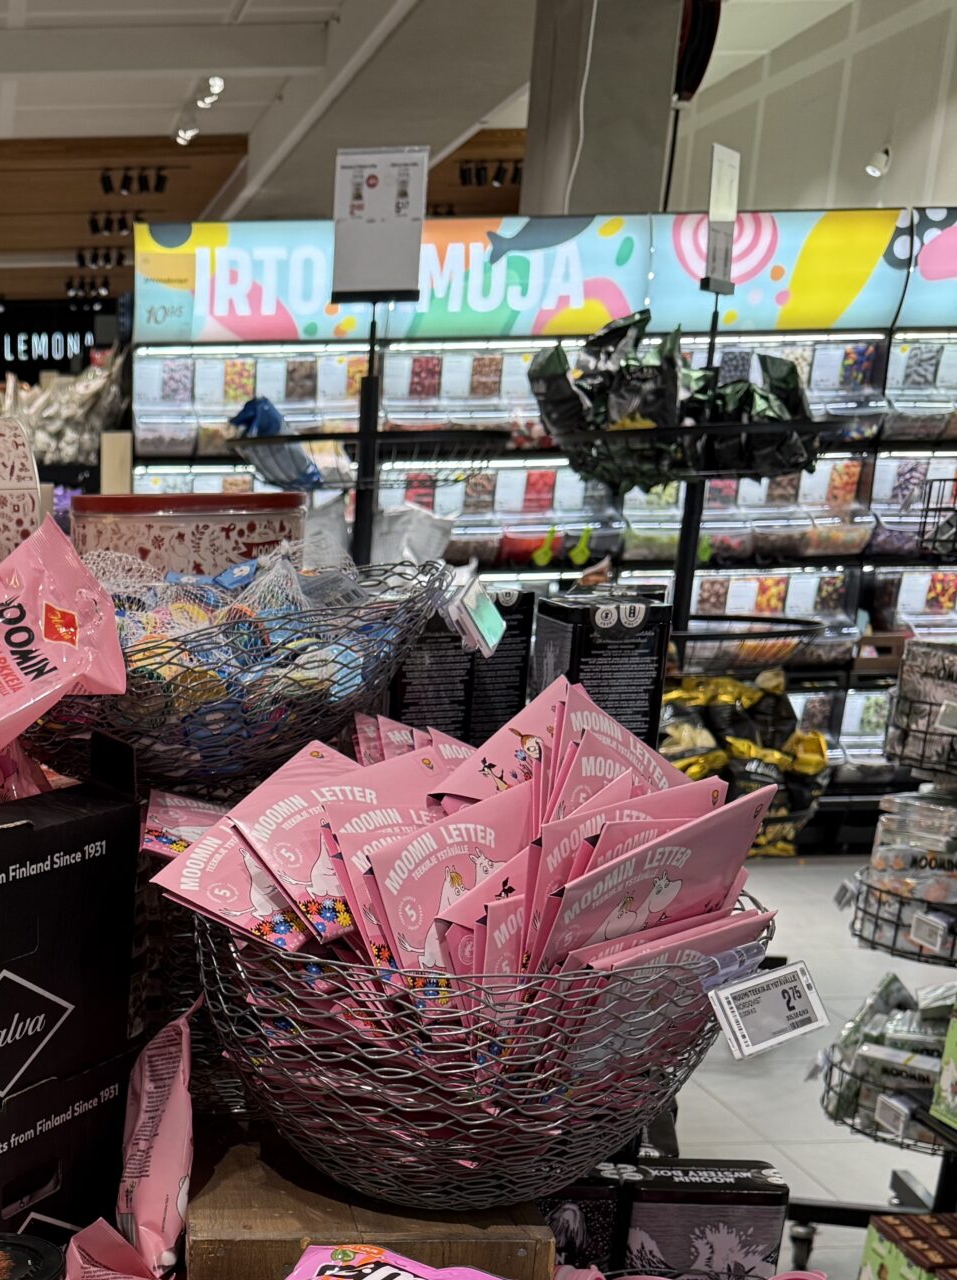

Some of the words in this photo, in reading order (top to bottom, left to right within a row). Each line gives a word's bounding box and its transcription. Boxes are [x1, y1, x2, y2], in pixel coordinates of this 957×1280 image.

[570, 710, 624, 742] MOOMIN
[628, 733, 669, 791] LETTER
[249, 793, 310, 850] MOOMIN
[310, 784, 379, 806] LETTER
[544, 812, 607, 874] MOOMIN
[8, 855, 52, 882] Finland
[52, 848, 83, 869] Since
[83, 840, 108, 861] 1931
[180, 835, 223, 892] MOOMIN
[384, 831, 440, 897] MOOMIN
[440, 822, 496, 849] LETTER
[562, 857, 638, 925] MOOMIN
[642, 845, 693, 871] LETTER
[10, 1129, 35, 1151] from
[36, 1106, 73, 1137] Finland
[73, 1097, 99, 1118] Since
[99, 1082, 120, 1106] 1931
